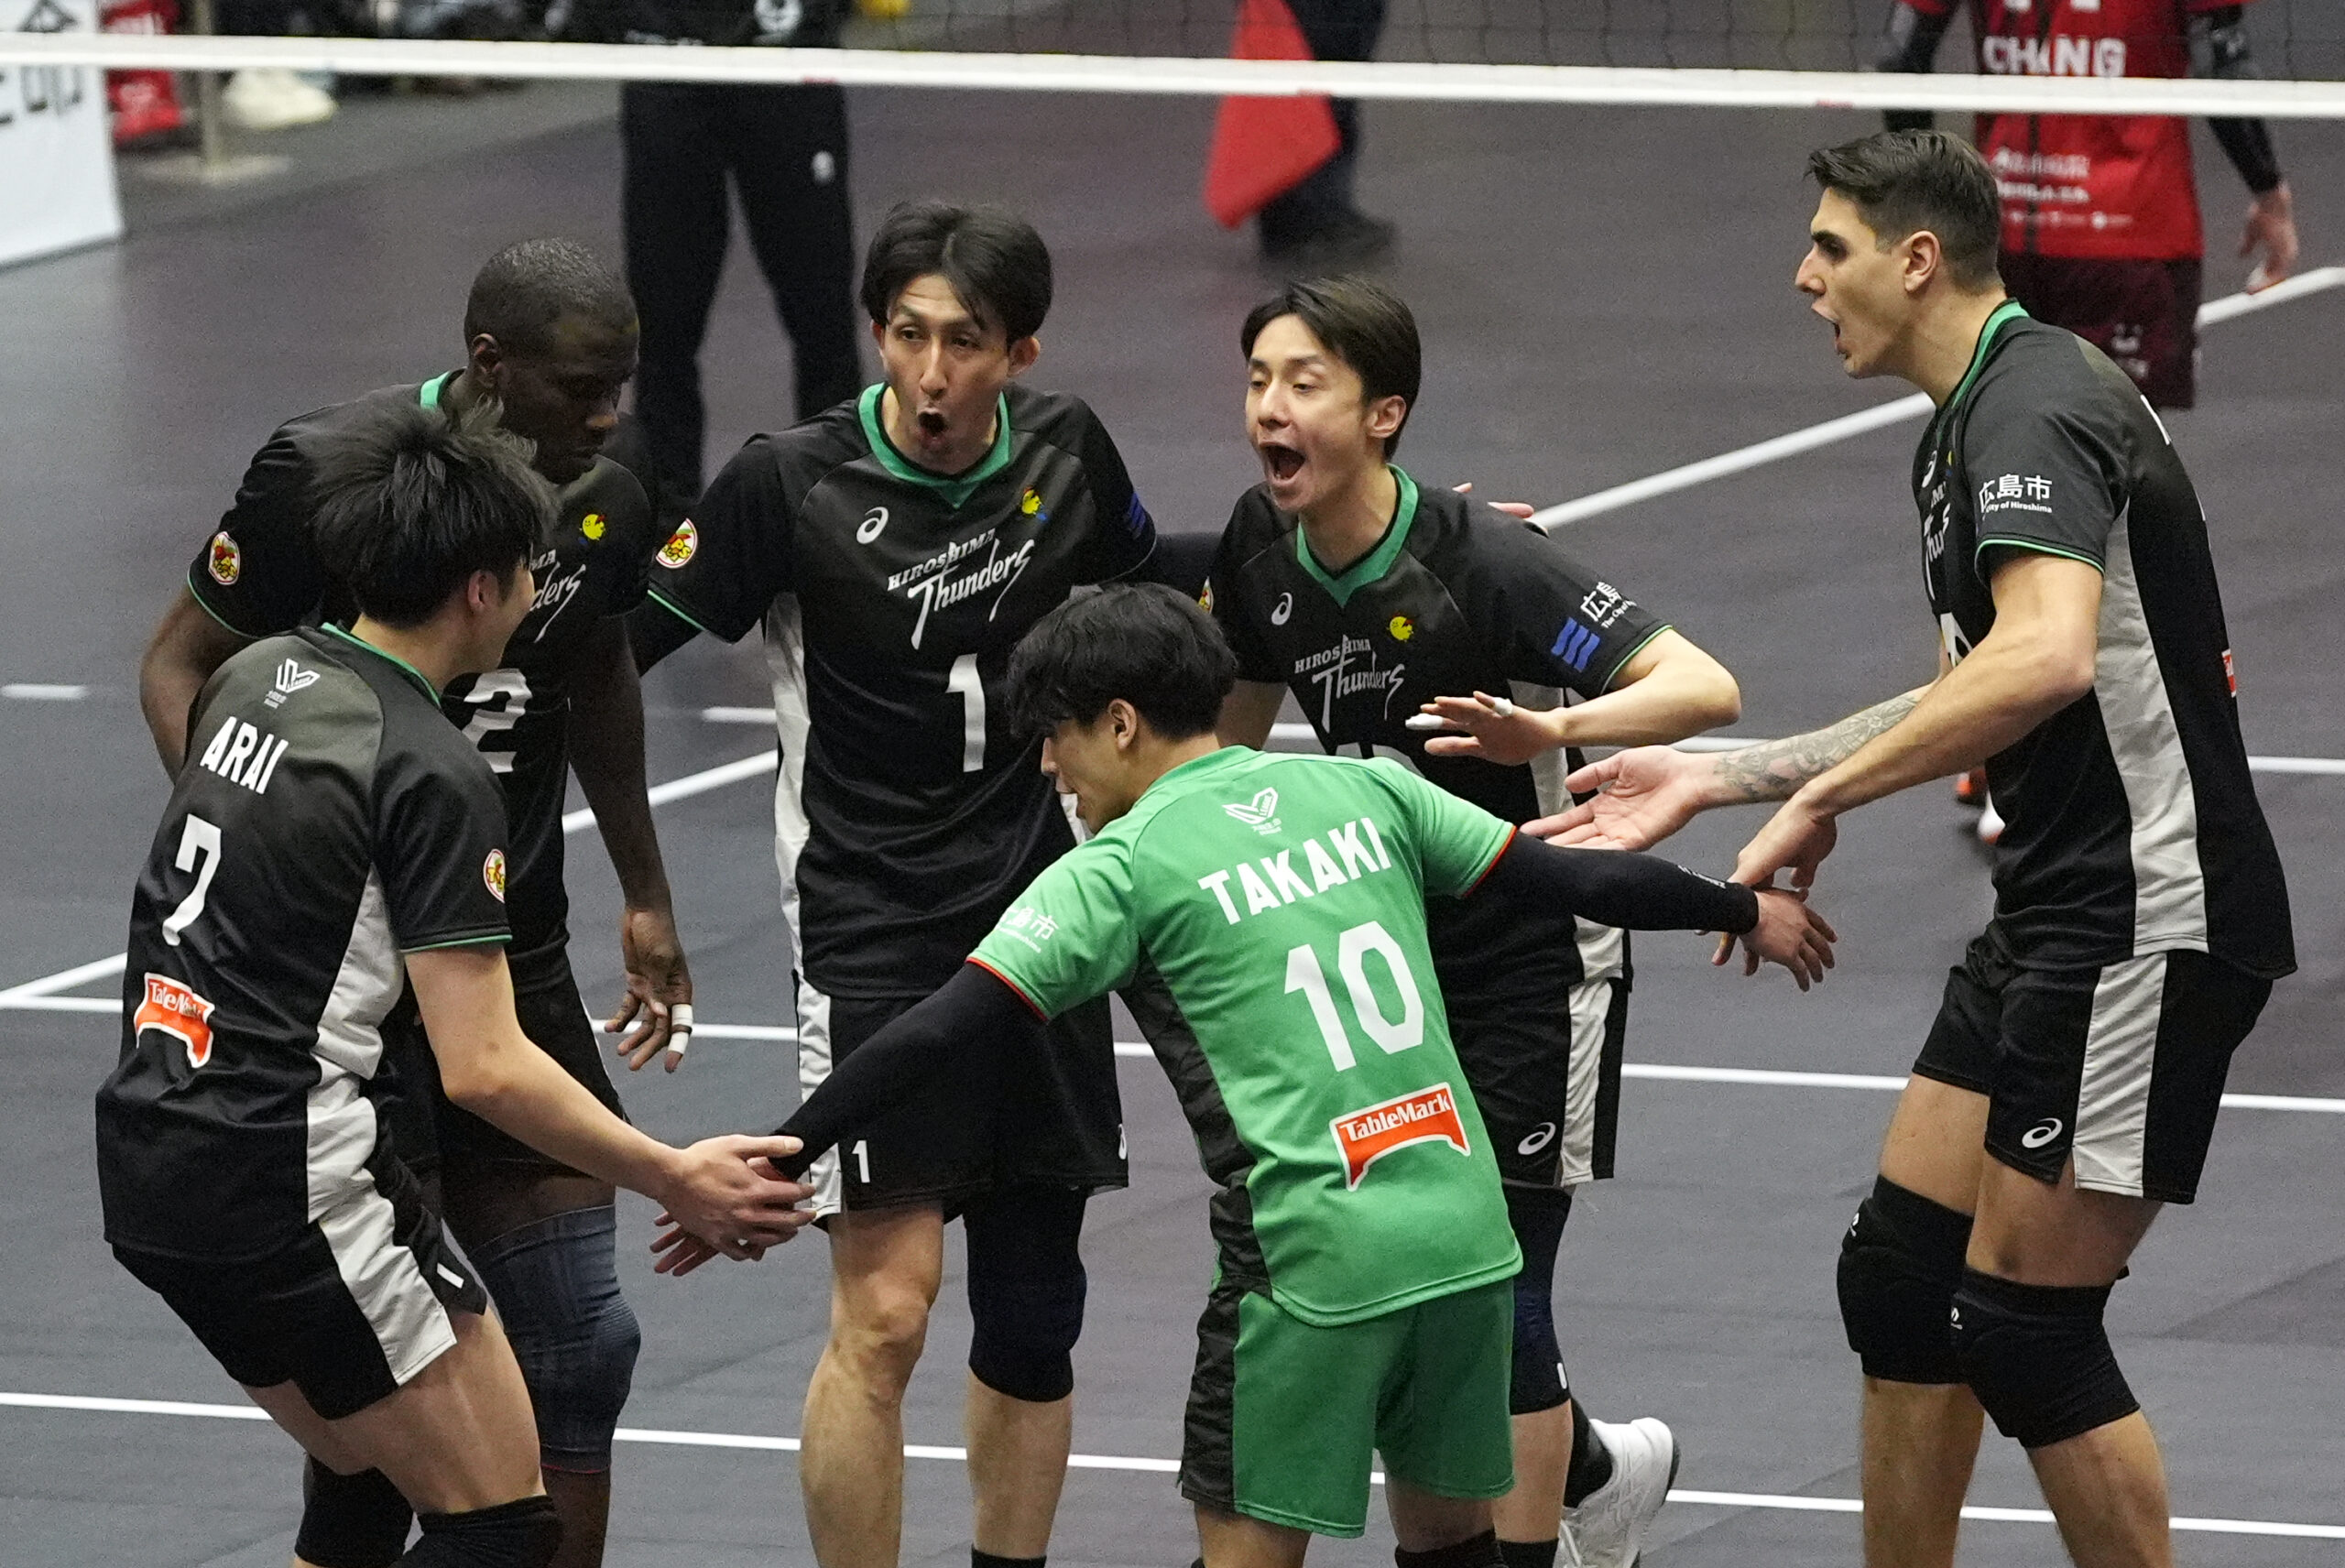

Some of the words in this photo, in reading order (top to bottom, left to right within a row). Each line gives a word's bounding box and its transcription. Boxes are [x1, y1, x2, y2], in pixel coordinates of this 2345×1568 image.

[1982, 35, 2127, 77] CHANG
[1979, 473, 2053, 514] 広島市
[2011, 501, 2053, 513] Hiroshima
[887, 527, 999, 592] HIROSHIMA
[907, 539, 1035, 650] Thunders
[1294, 636, 1371, 674] HIROSHIMA
[1312, 635, 1405, 734] Thunders
[461, 669, 533, 773] 2
[945, 653, 987, 772] 1
[201, 715, 289, 795] ARAI
[162, 812, 222, 947] 7
[1197, 817, 1391, 925] TAKAKI
[1284, 920, 1424, 1072] 10
[1339, 1090, 1452, 1143] TableMark
[850, 1139, 871, 1184] 1
